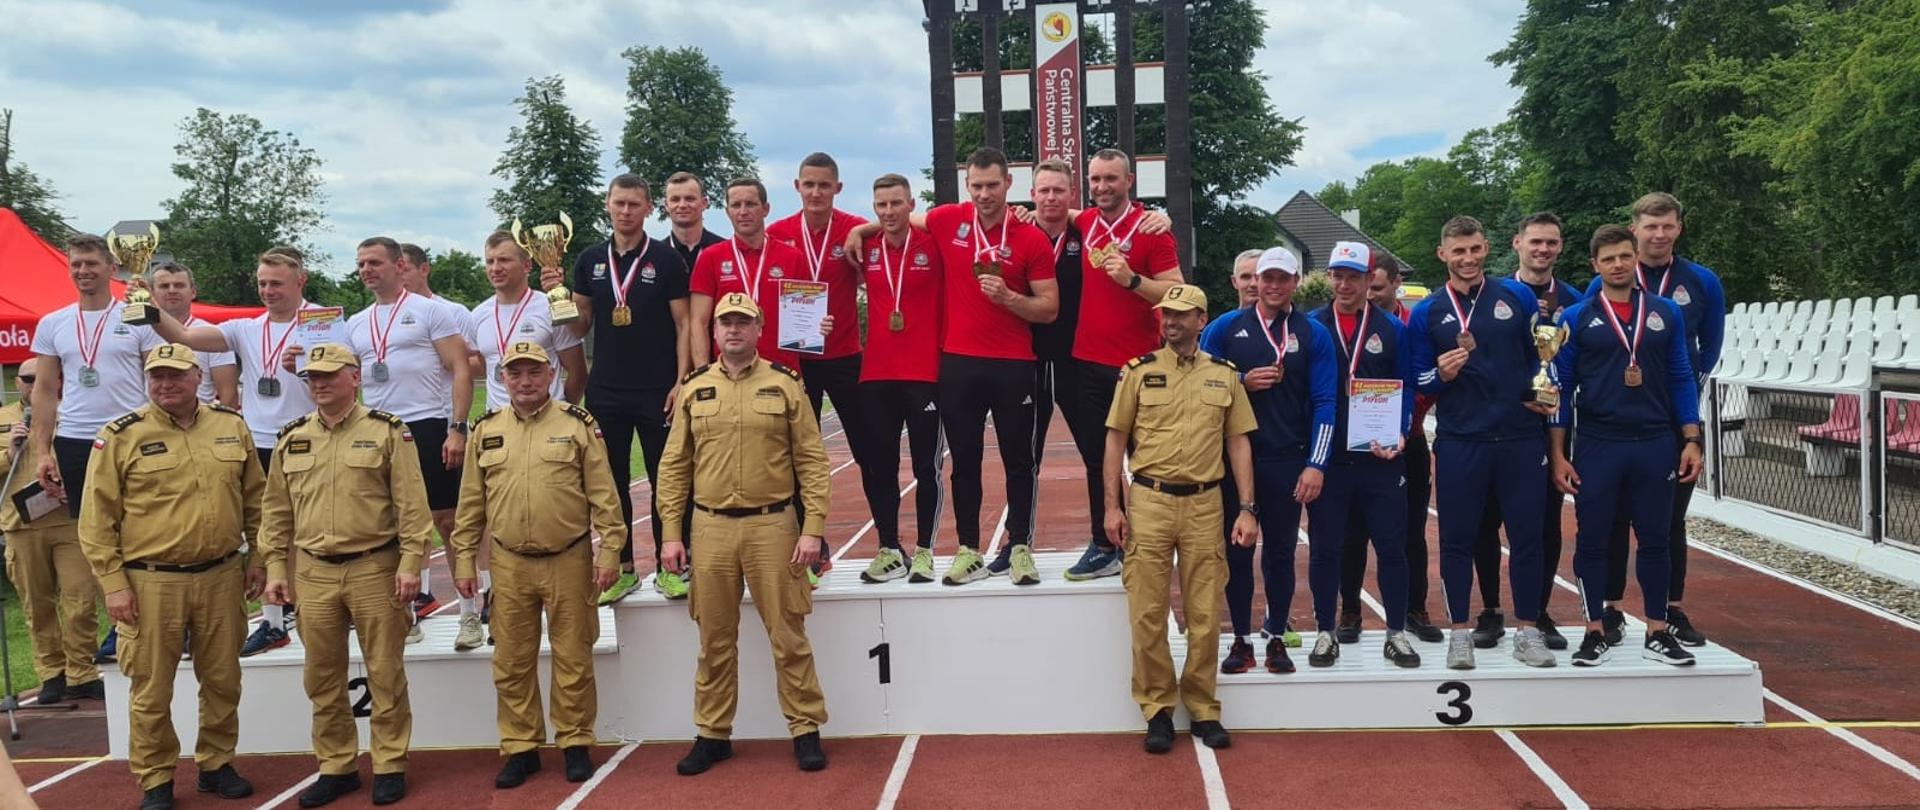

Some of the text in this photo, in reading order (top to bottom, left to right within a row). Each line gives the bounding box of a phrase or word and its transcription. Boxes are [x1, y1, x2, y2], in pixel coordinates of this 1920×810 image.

[1044, 69, 1060, 150] Państwowej
[1060, 67, 1075, 135] Centralna
[868, 642, 891, 685] 1
[347, 676, 373, 718] 2
[1435, 681, 1473, 725] 3
